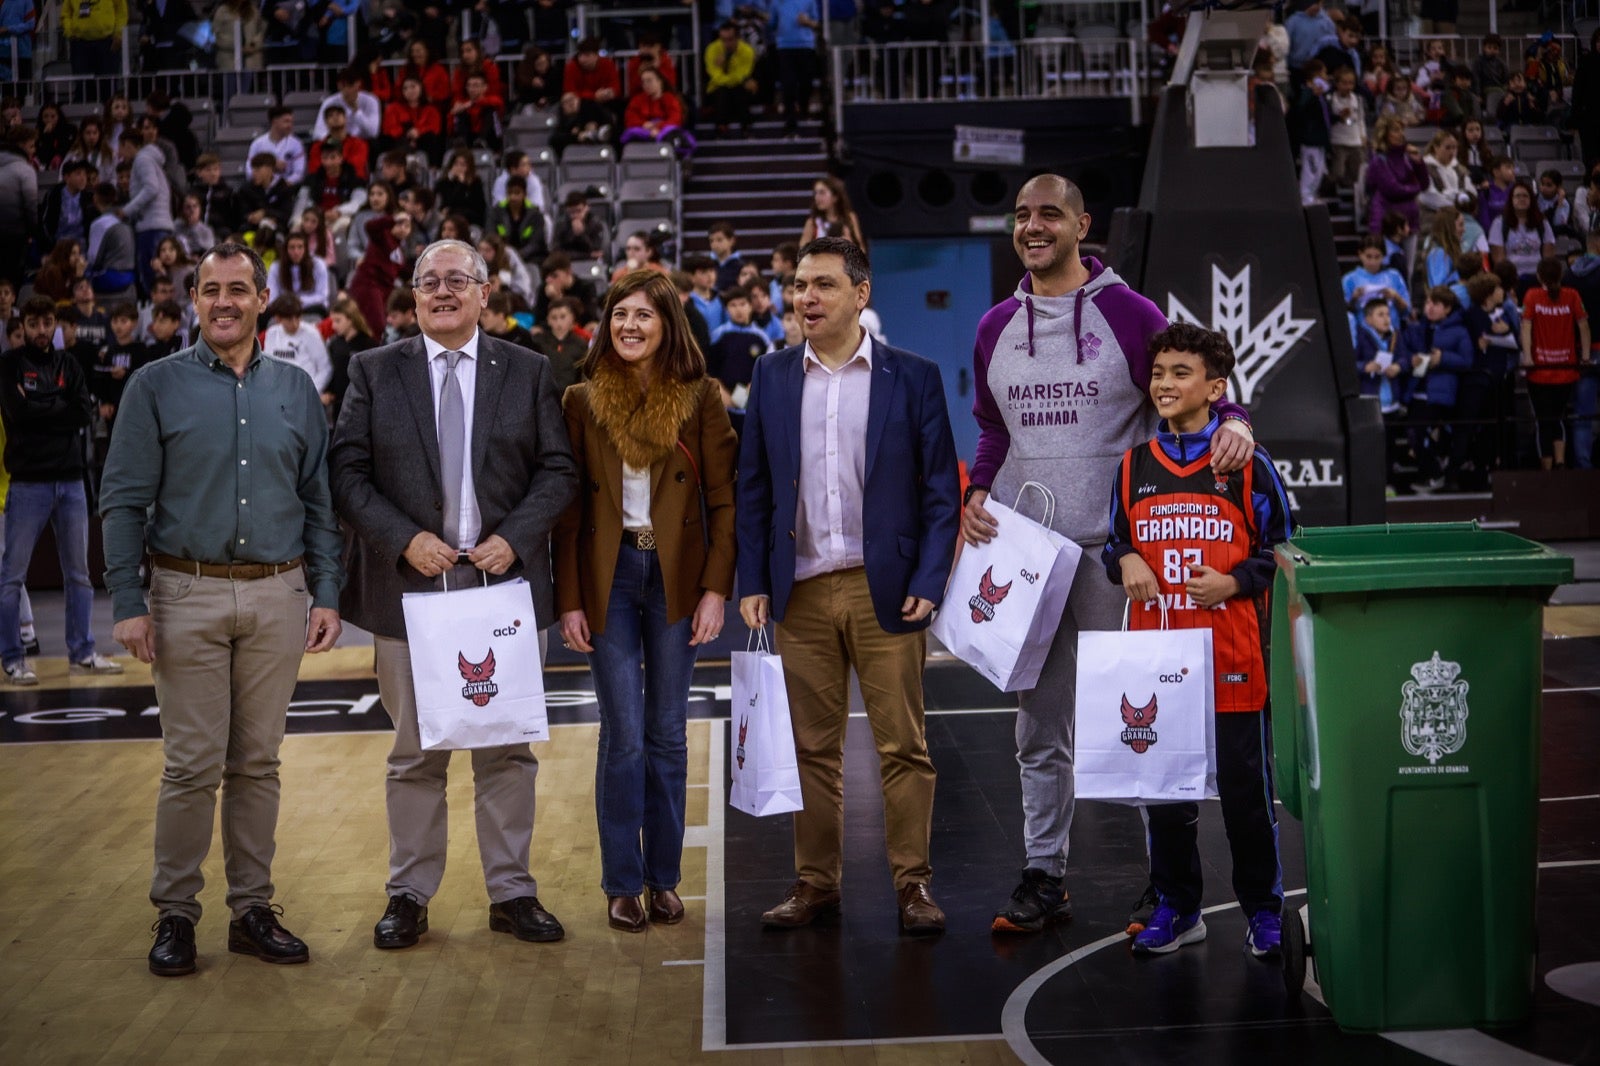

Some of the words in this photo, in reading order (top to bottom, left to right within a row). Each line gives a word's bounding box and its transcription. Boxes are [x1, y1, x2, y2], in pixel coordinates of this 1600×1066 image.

[1008, 381, 1099, 401] MARISTAS
[1008, 402, 1032, 410] CLUB
[1039, 399, 1099, 409] DEPORTIVO
[1021, 409, 1078, 427] GRANADA
[1150, 503, 1202, 516] FUNDACION
[1205, 504, 1218, 515] CB
[1136, 517, 1233, 542] GRANADA
[1020, 568, 1035, 585] acb
[493, 626, 517, 637] acb
[1159, 673, 1183, 683] acb
[463, 684, 497, 696] GRANADA
[1121, 731, 1157, 741] GRANADA
